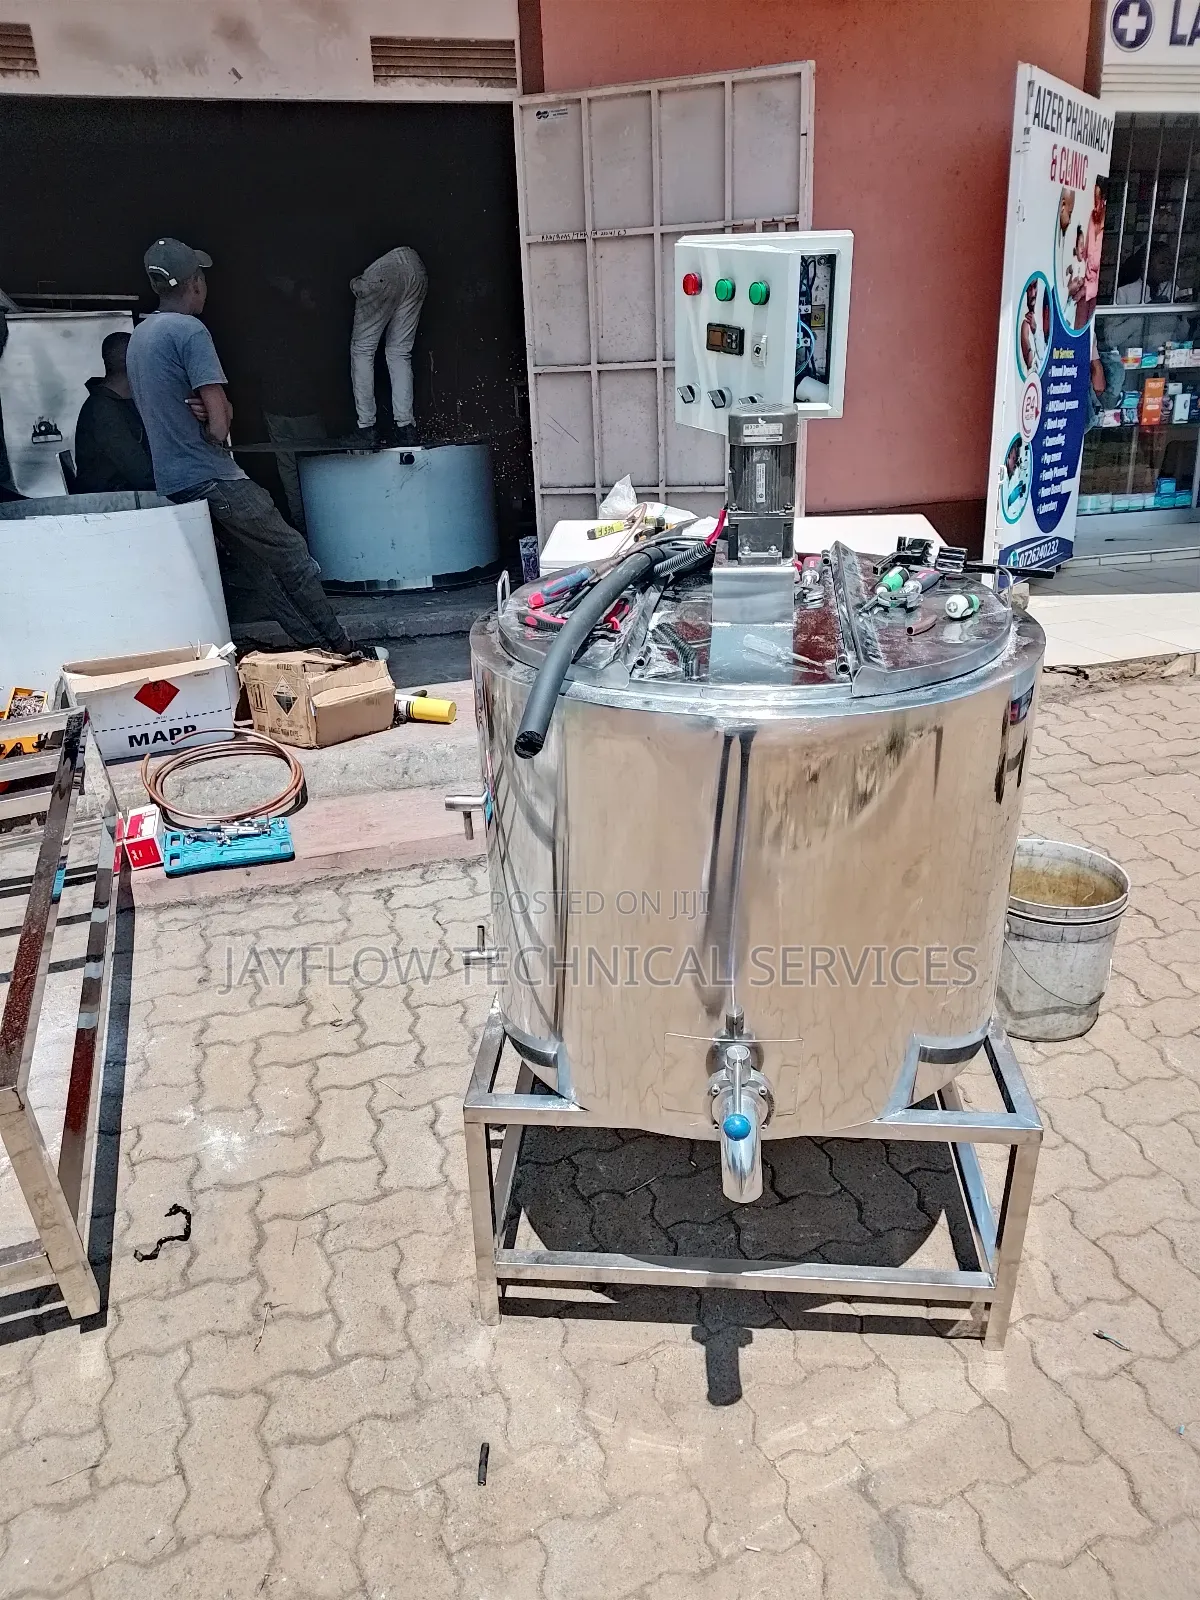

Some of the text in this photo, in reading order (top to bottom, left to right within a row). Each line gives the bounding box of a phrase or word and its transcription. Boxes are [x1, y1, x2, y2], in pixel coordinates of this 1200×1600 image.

[1064, 99, 1113, 154] PHARMACY
[1050, 143, 1089, 191] & CLINIC
[1025, 396, 1036, 412] 24
[128, 724, 197, 748] MAPP
